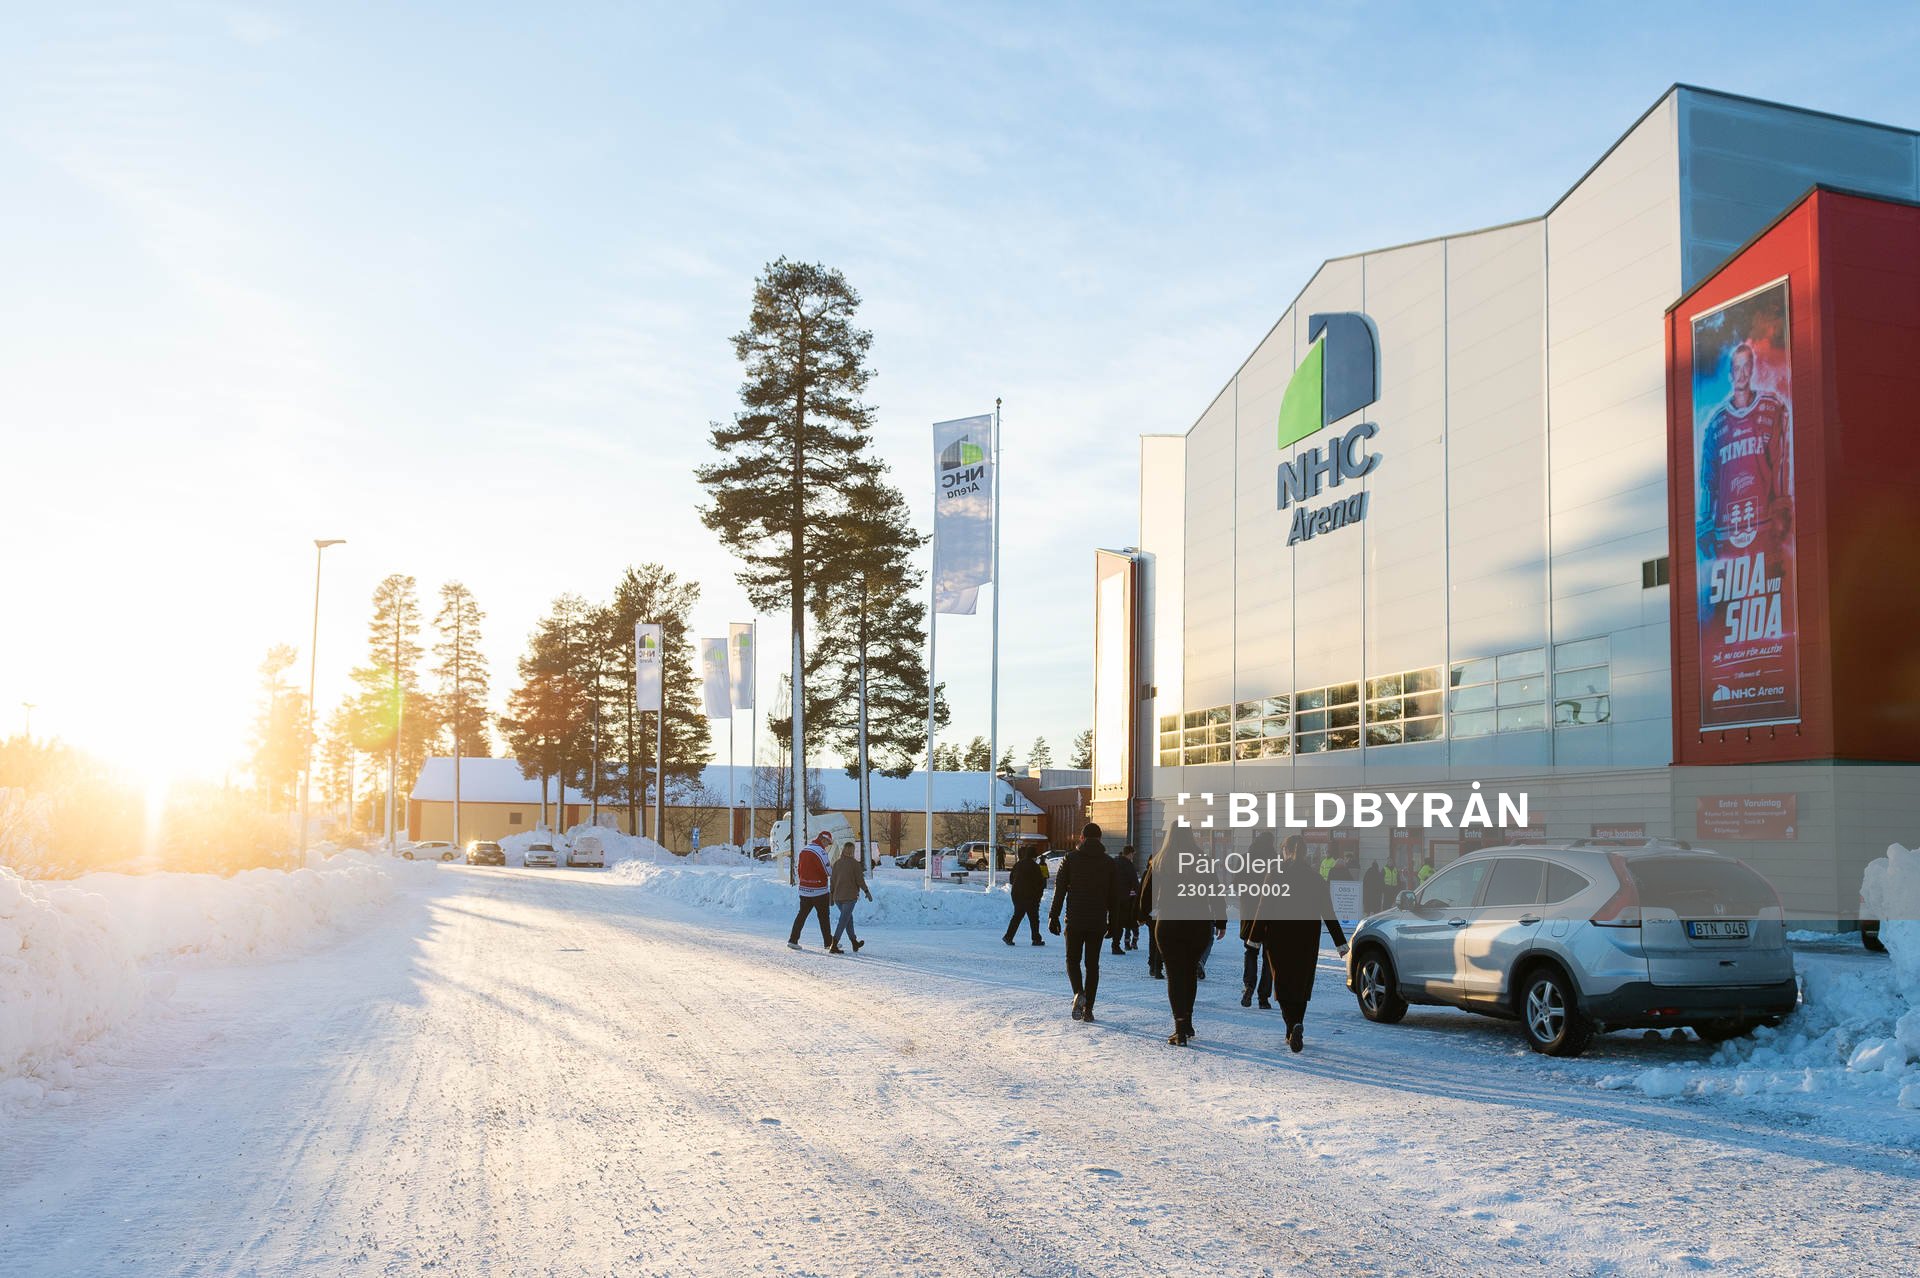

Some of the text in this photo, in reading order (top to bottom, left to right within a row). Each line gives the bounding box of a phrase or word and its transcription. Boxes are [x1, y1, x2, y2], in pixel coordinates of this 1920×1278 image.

[1277, 421, 1382, 510] NHC
[1286, 490, 1370, 547] Arena
[1710, 552, 1781, 604] SIDA VID
[1725, 593, 1783, 645] SIDA
[1731, 686, 1784, 700] NHC Arena
[1719, 799, 1738, 808] Entré
[1695, 923, 1746, 935] BTN 046
